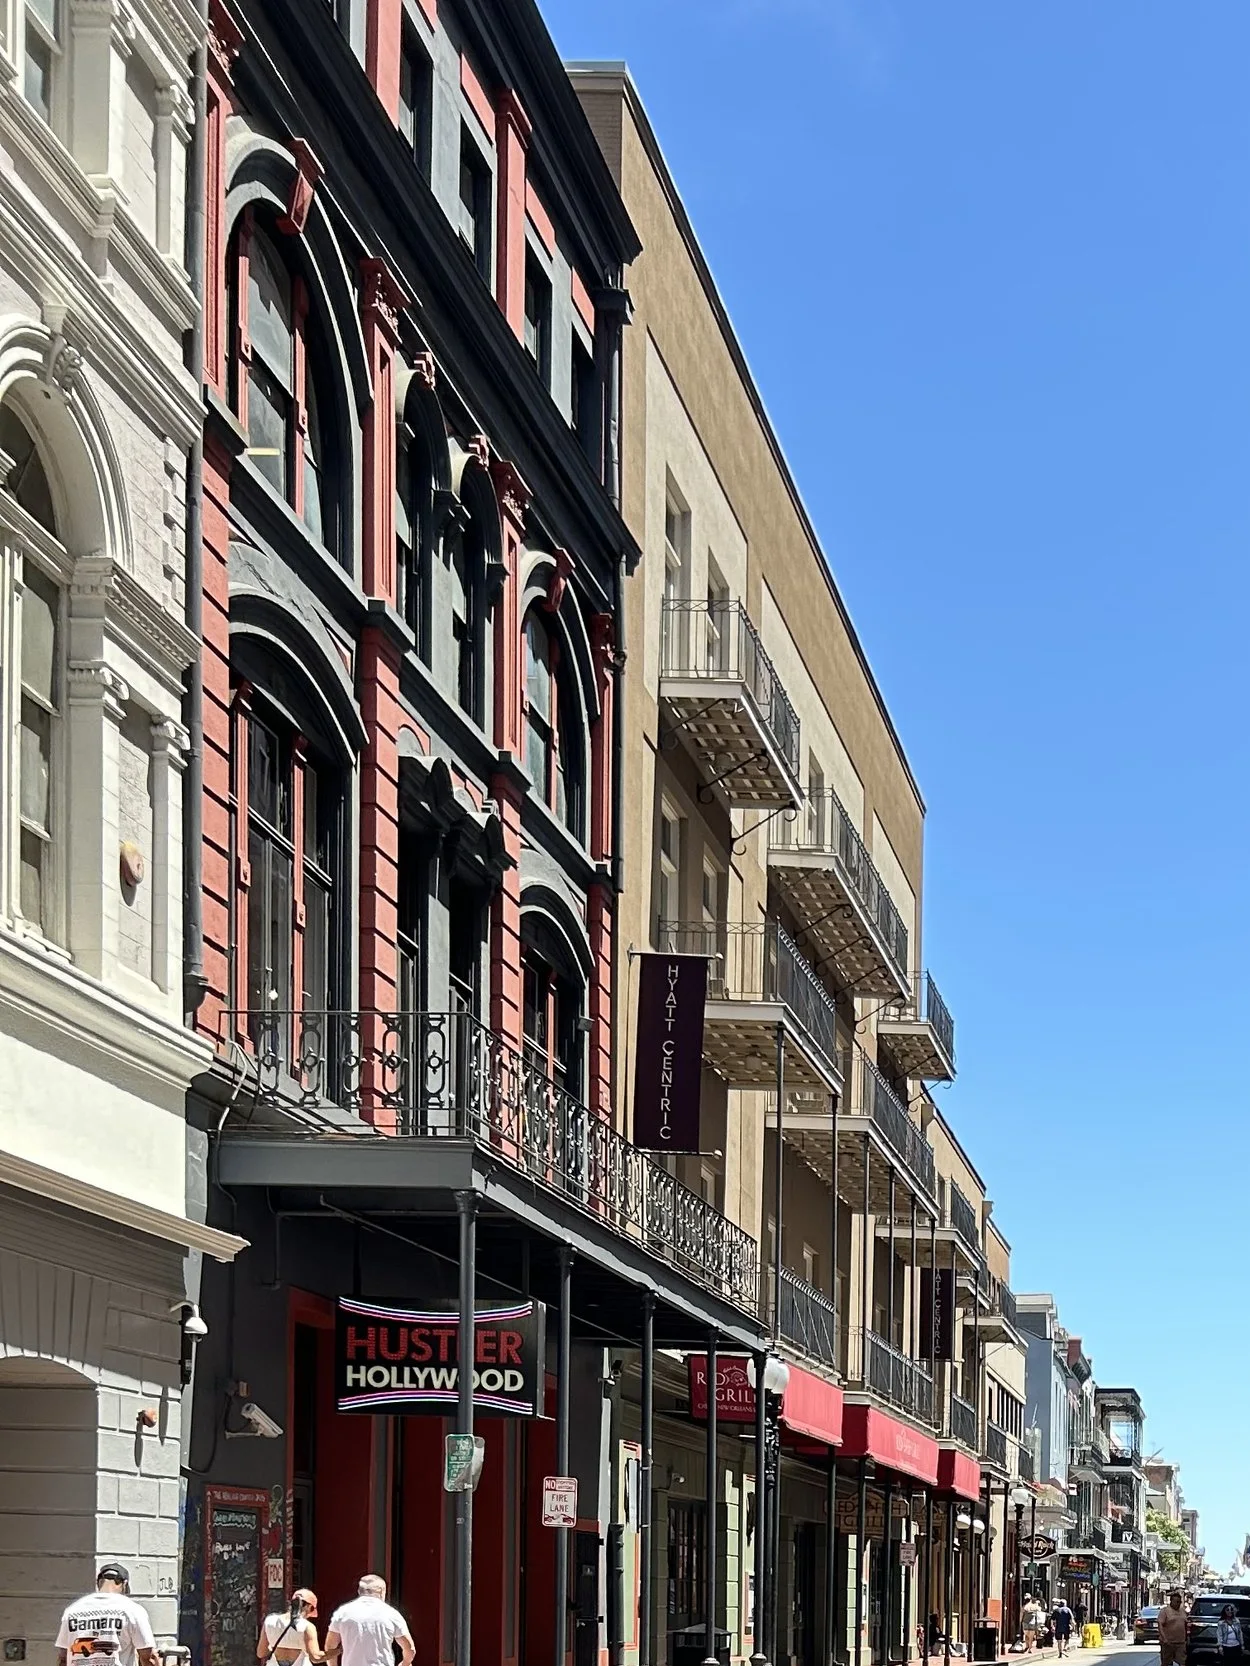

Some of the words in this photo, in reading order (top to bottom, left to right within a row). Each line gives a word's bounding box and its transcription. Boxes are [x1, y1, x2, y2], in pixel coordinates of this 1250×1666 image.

[665, 965, 679, 1032] HYATT
[660, 1040, 675, 1139] CENTRIC
[347, 1326, 523, 1364] HUSTER
[697, 1371, 726, 1386] RD
[545, 1480, 556, 1490] NO
[552, 1494, 568, 1502] FIRE
[550, 1505, 569, 1513] LANE
[69, 1618, 122, 1632] Camaro
